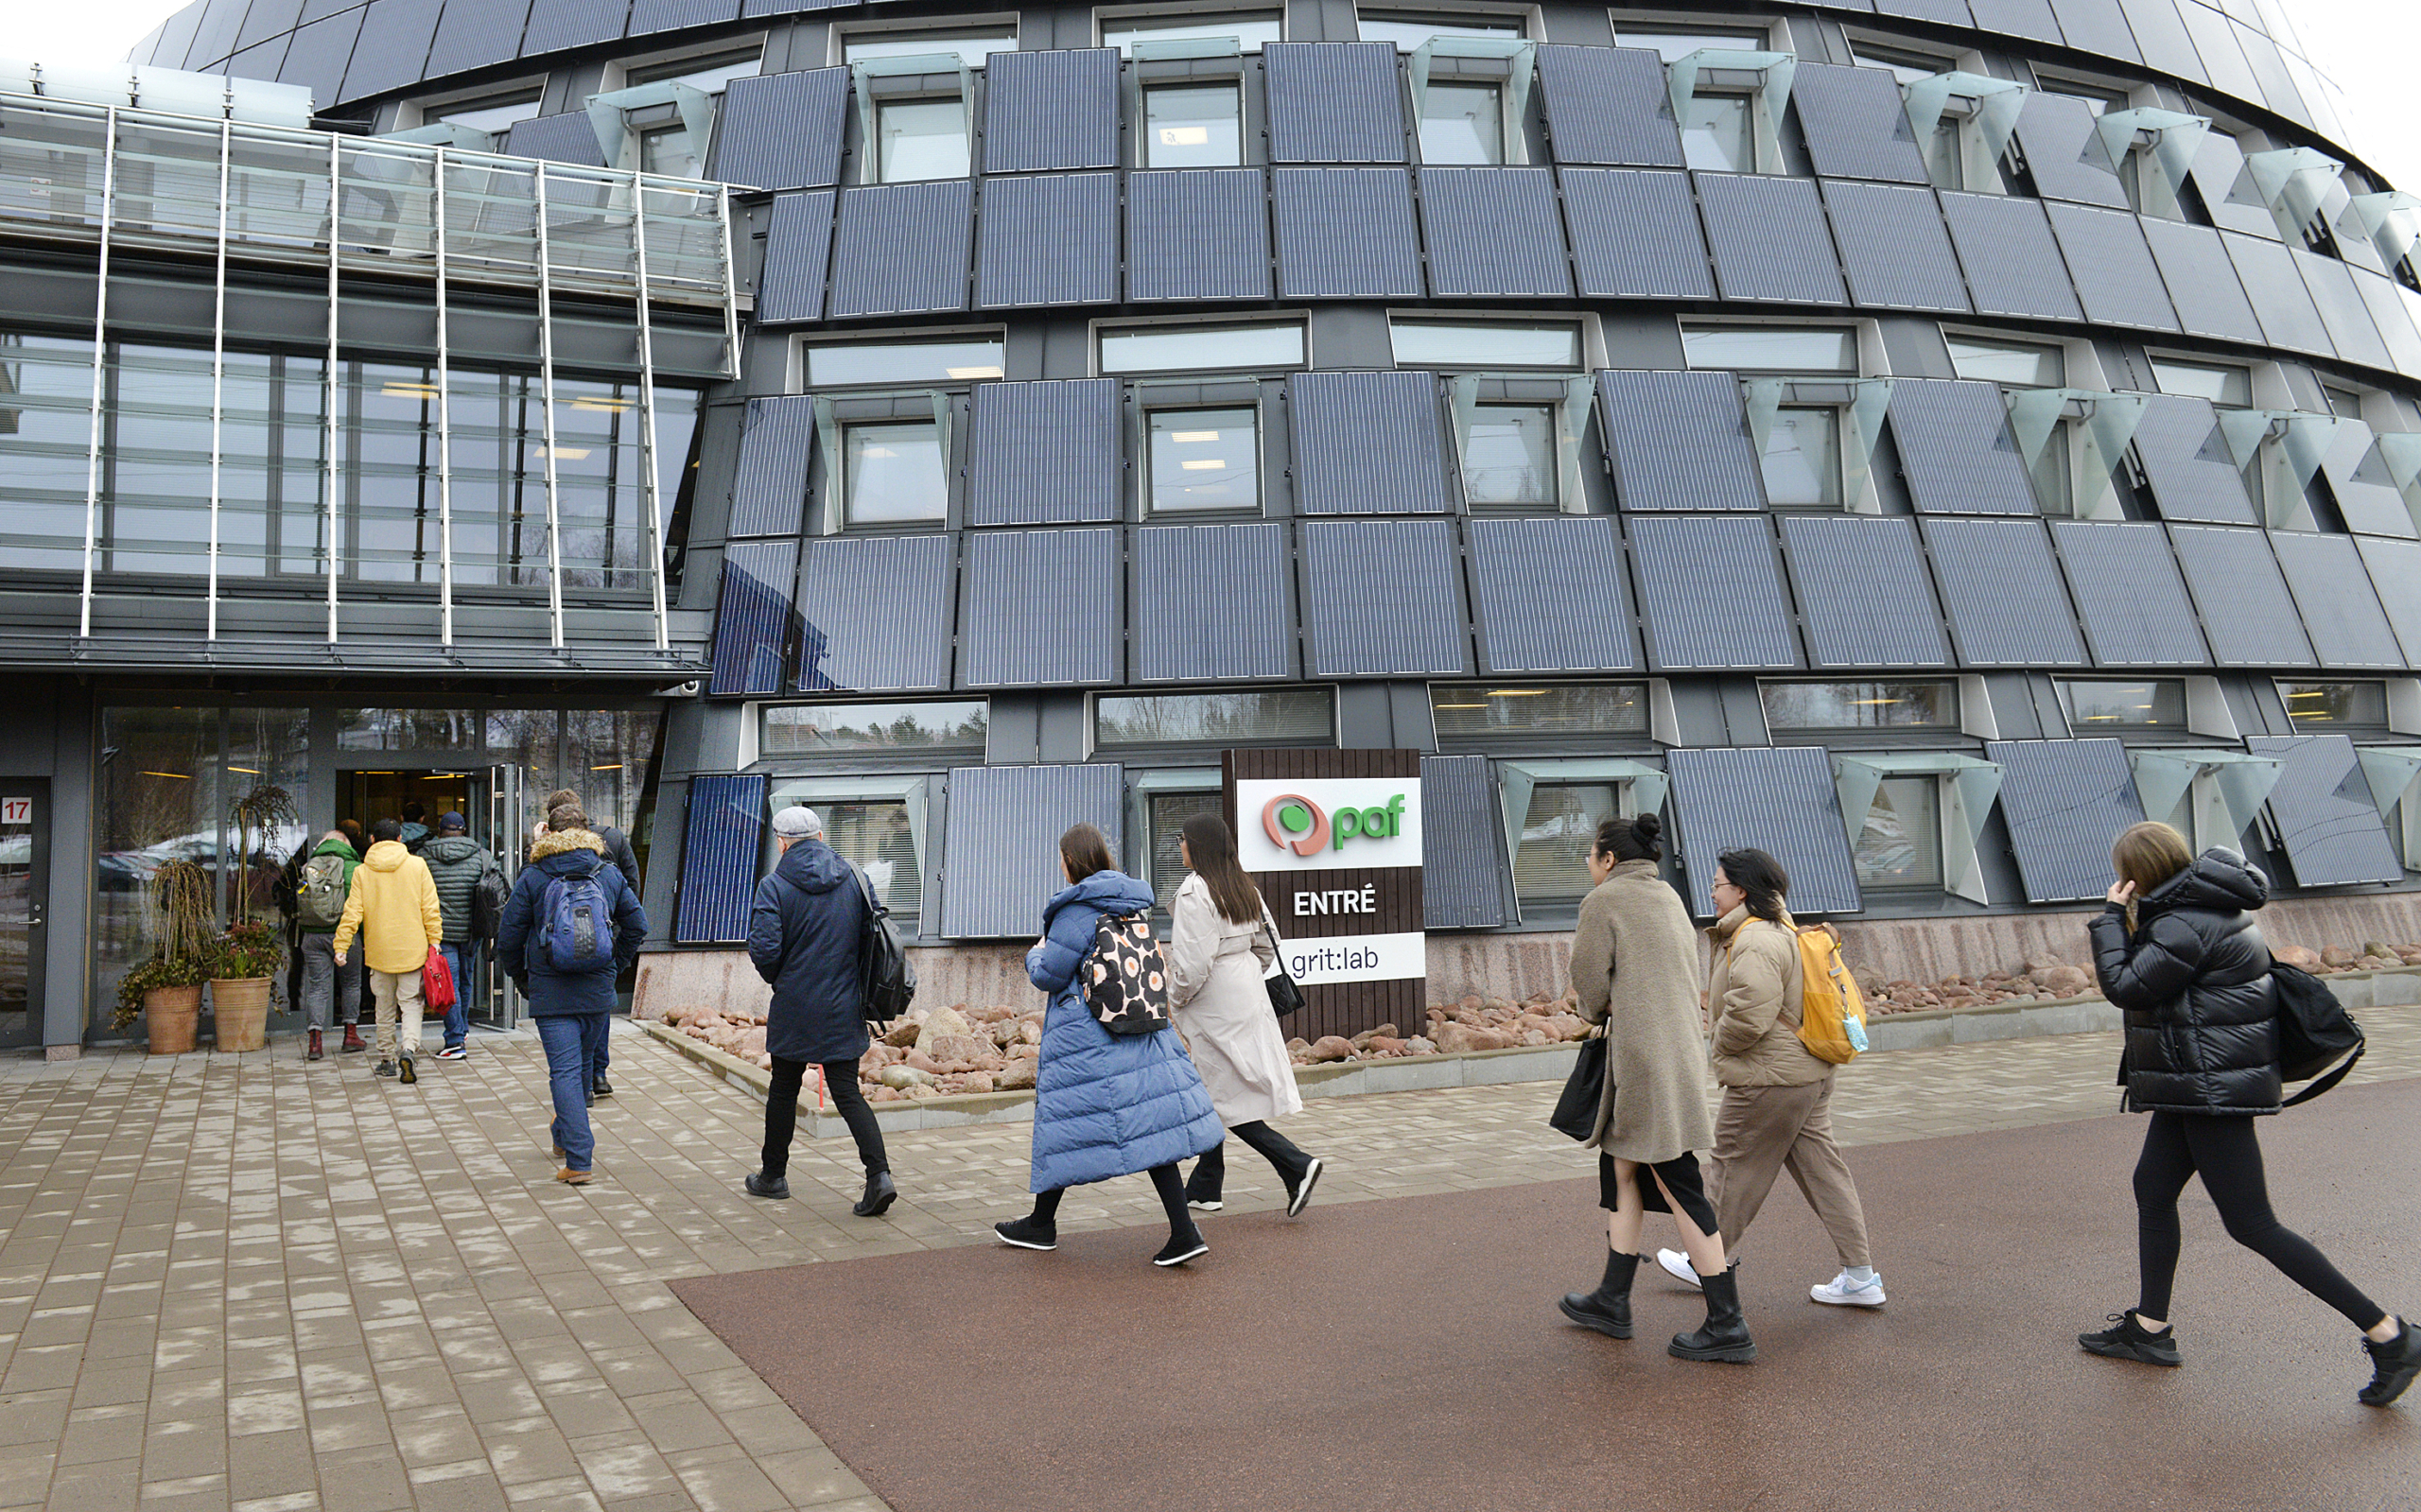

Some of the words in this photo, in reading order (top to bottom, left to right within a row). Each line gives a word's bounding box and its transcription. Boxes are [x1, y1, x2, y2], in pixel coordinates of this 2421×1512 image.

[5, 801, 29, 820] 17
[1332, 793, 1405, 851] paf
[1294, 882, 1377, 917] ENTRÉ
[1292, 946, 1379, 980] grit:lab
